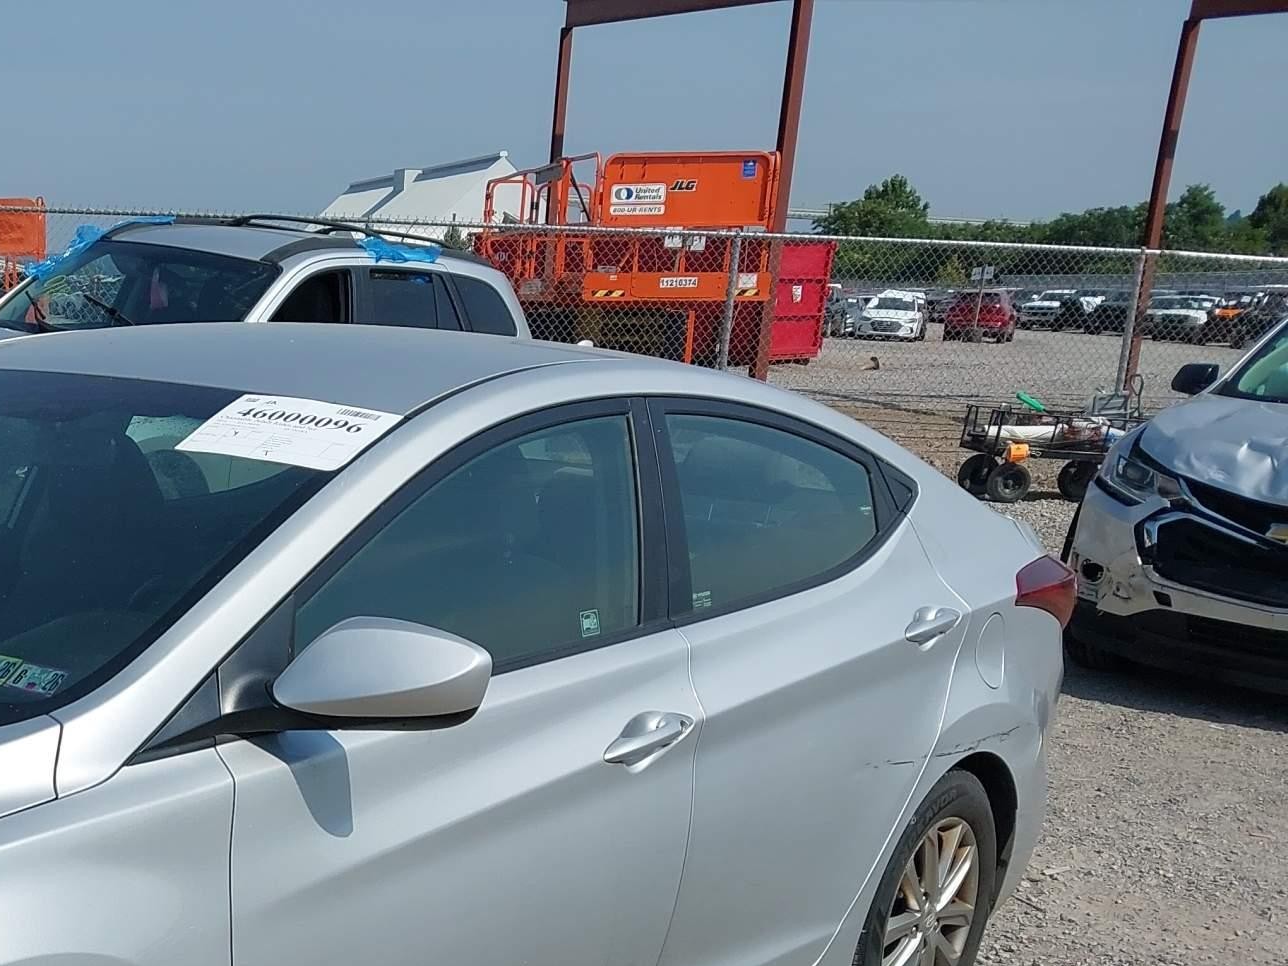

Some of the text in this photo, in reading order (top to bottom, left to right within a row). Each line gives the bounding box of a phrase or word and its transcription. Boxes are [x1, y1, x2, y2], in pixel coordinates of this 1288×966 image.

[669, 180, 697, 191] JLG
[634, 193, 662, 201] Rentals
[237, 407, 365, 433] 46000096
